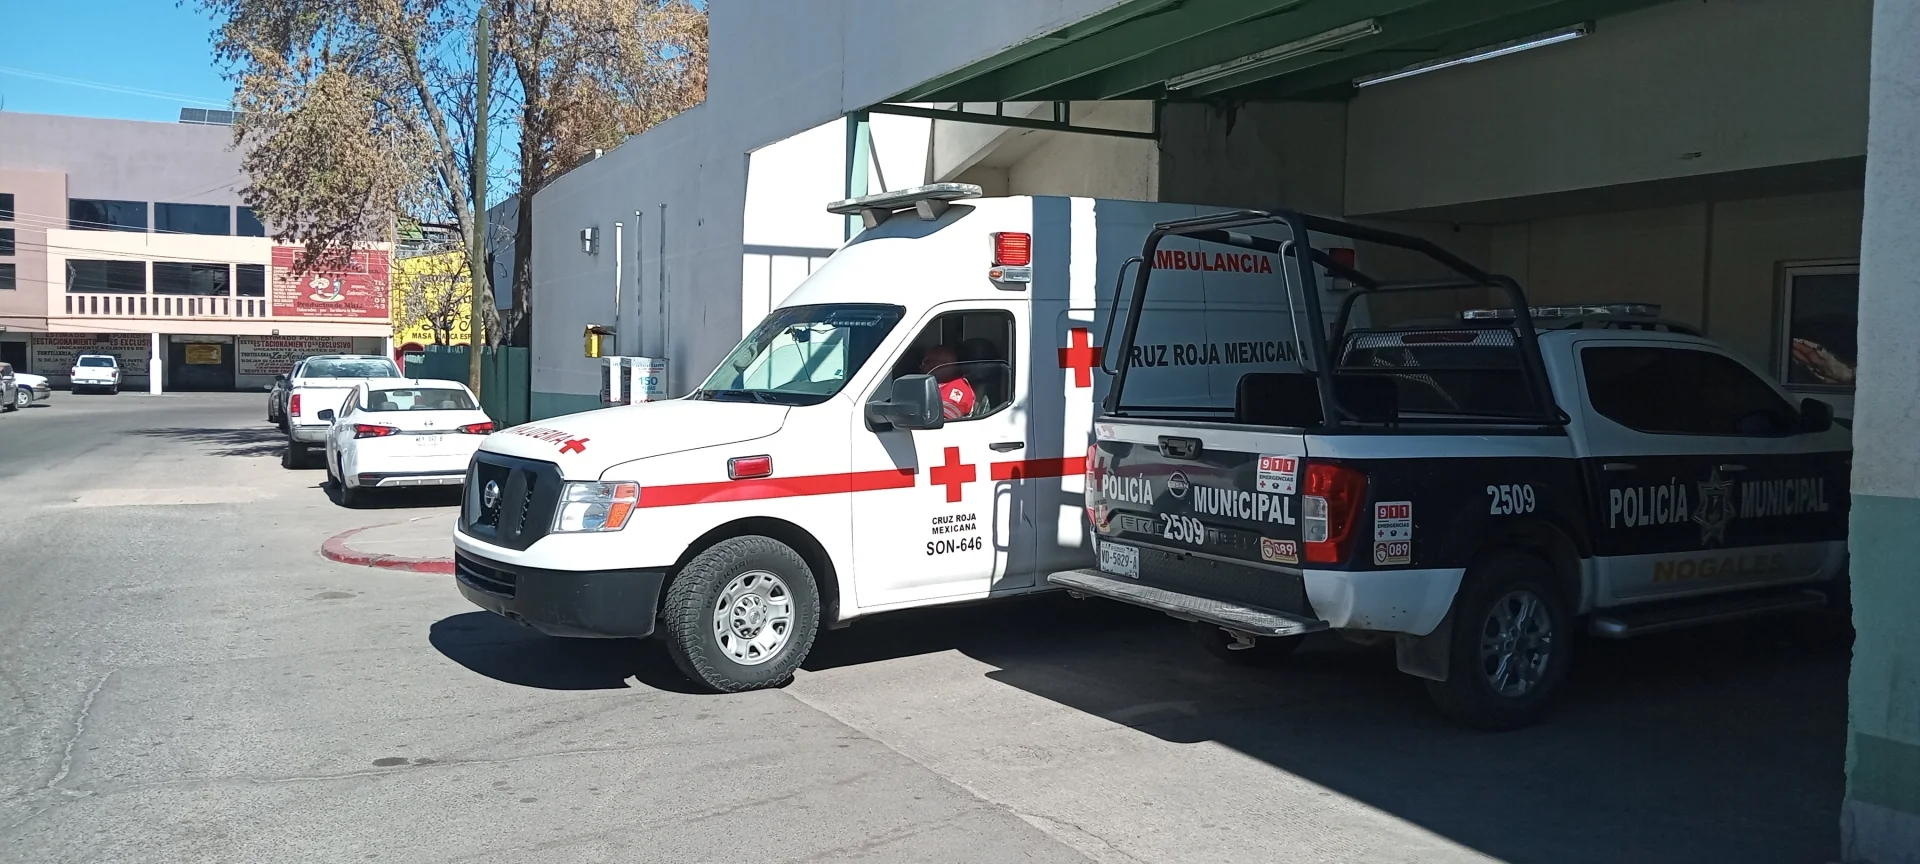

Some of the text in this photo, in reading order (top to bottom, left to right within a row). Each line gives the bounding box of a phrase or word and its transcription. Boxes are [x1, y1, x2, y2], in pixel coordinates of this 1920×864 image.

[36, 338, 97, 346] ESTACIONAMIENTO
[121, 339, 149, 347] EXCLUSI
[1130, 340, 1308, 367] RUZ ROJA MEXICANA
[1263, 460, 1291, 470] 911
[1102, 473, 1296, 525] POLICÍA MUNICIPAL
[1487, 484, 1536, 515] 2509
[1610, 477, 1829, 528] POLICÍA MUNICIPAL
[932, 513, 976, 525] CRUZ ROJA
[1380, 507, 1407, 517] 911
[932, 523, 976, 534] MEXICANA
[1161, 513, 1204, 545] 2509
[926, 536, 982, 556] SON-646
[1390, 544, 1408, 556] 089
[1653, 553, 1786, 583] NOGALES
